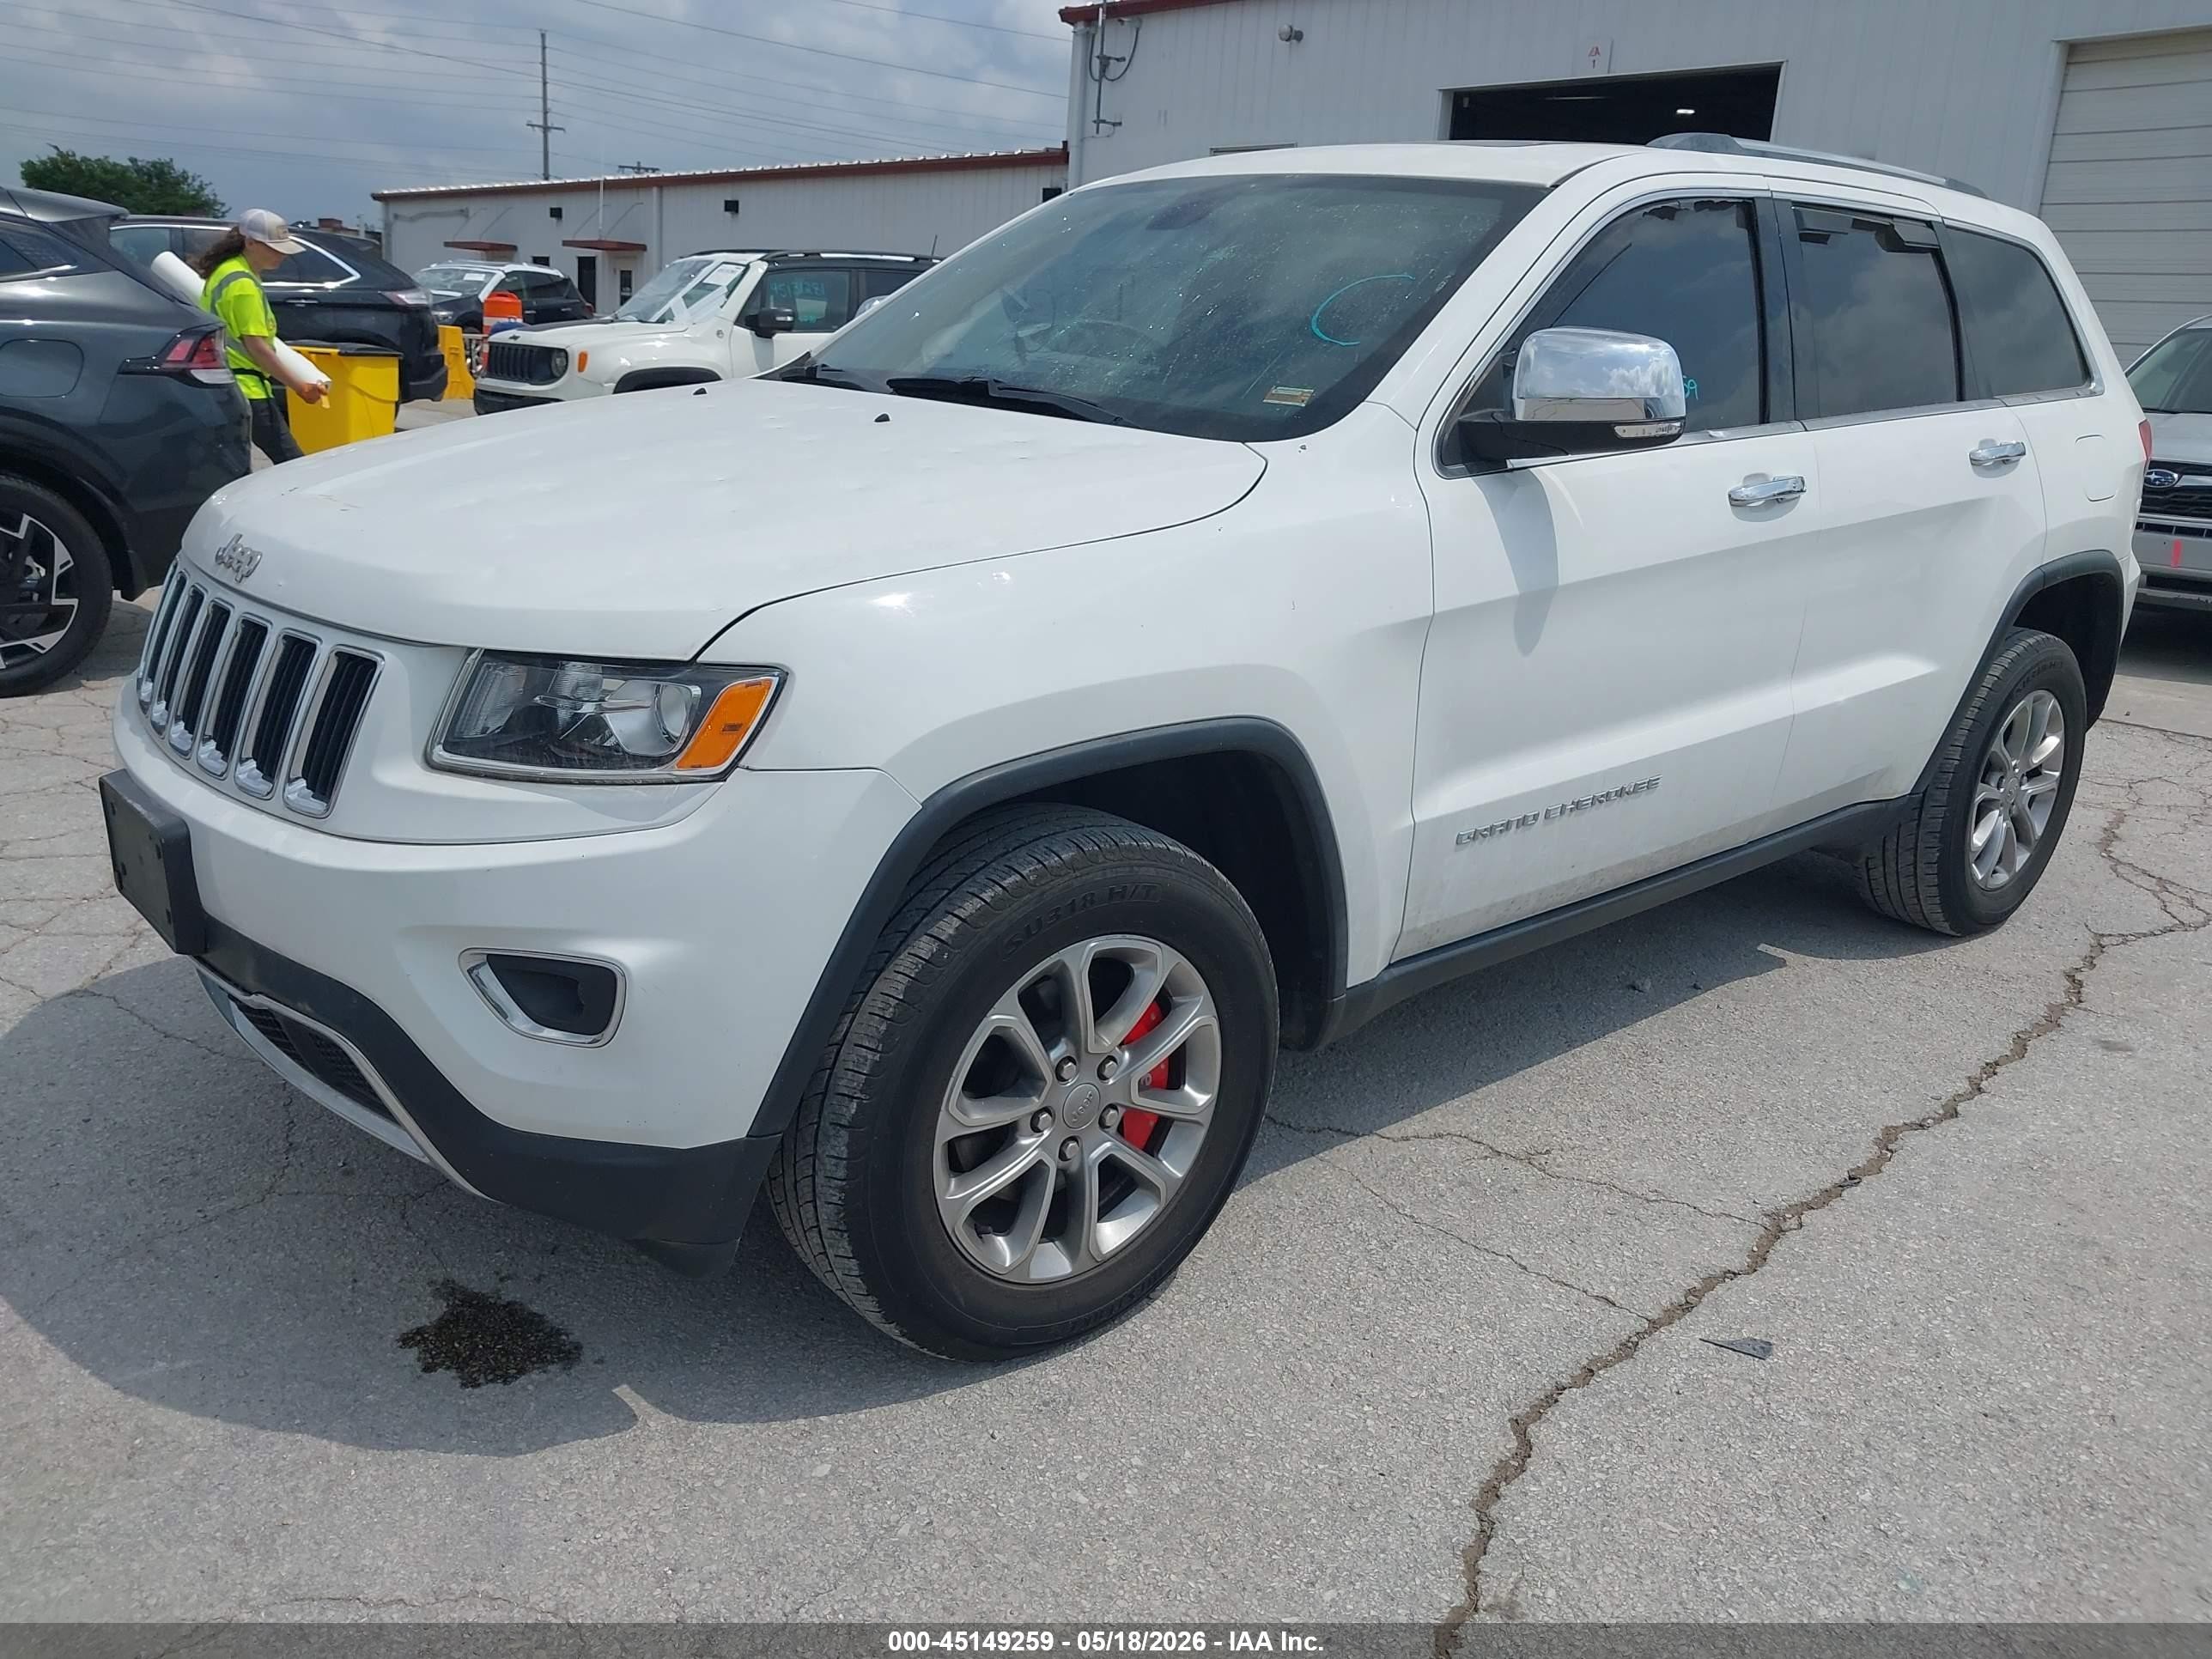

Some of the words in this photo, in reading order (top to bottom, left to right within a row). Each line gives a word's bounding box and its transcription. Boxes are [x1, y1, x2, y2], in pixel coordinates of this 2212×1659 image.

[215, 532, 263, 584] Jeep
[1455, 811, 1540, 847] GRAND
[1544, 774, 1663, 821] CHEROKEE
